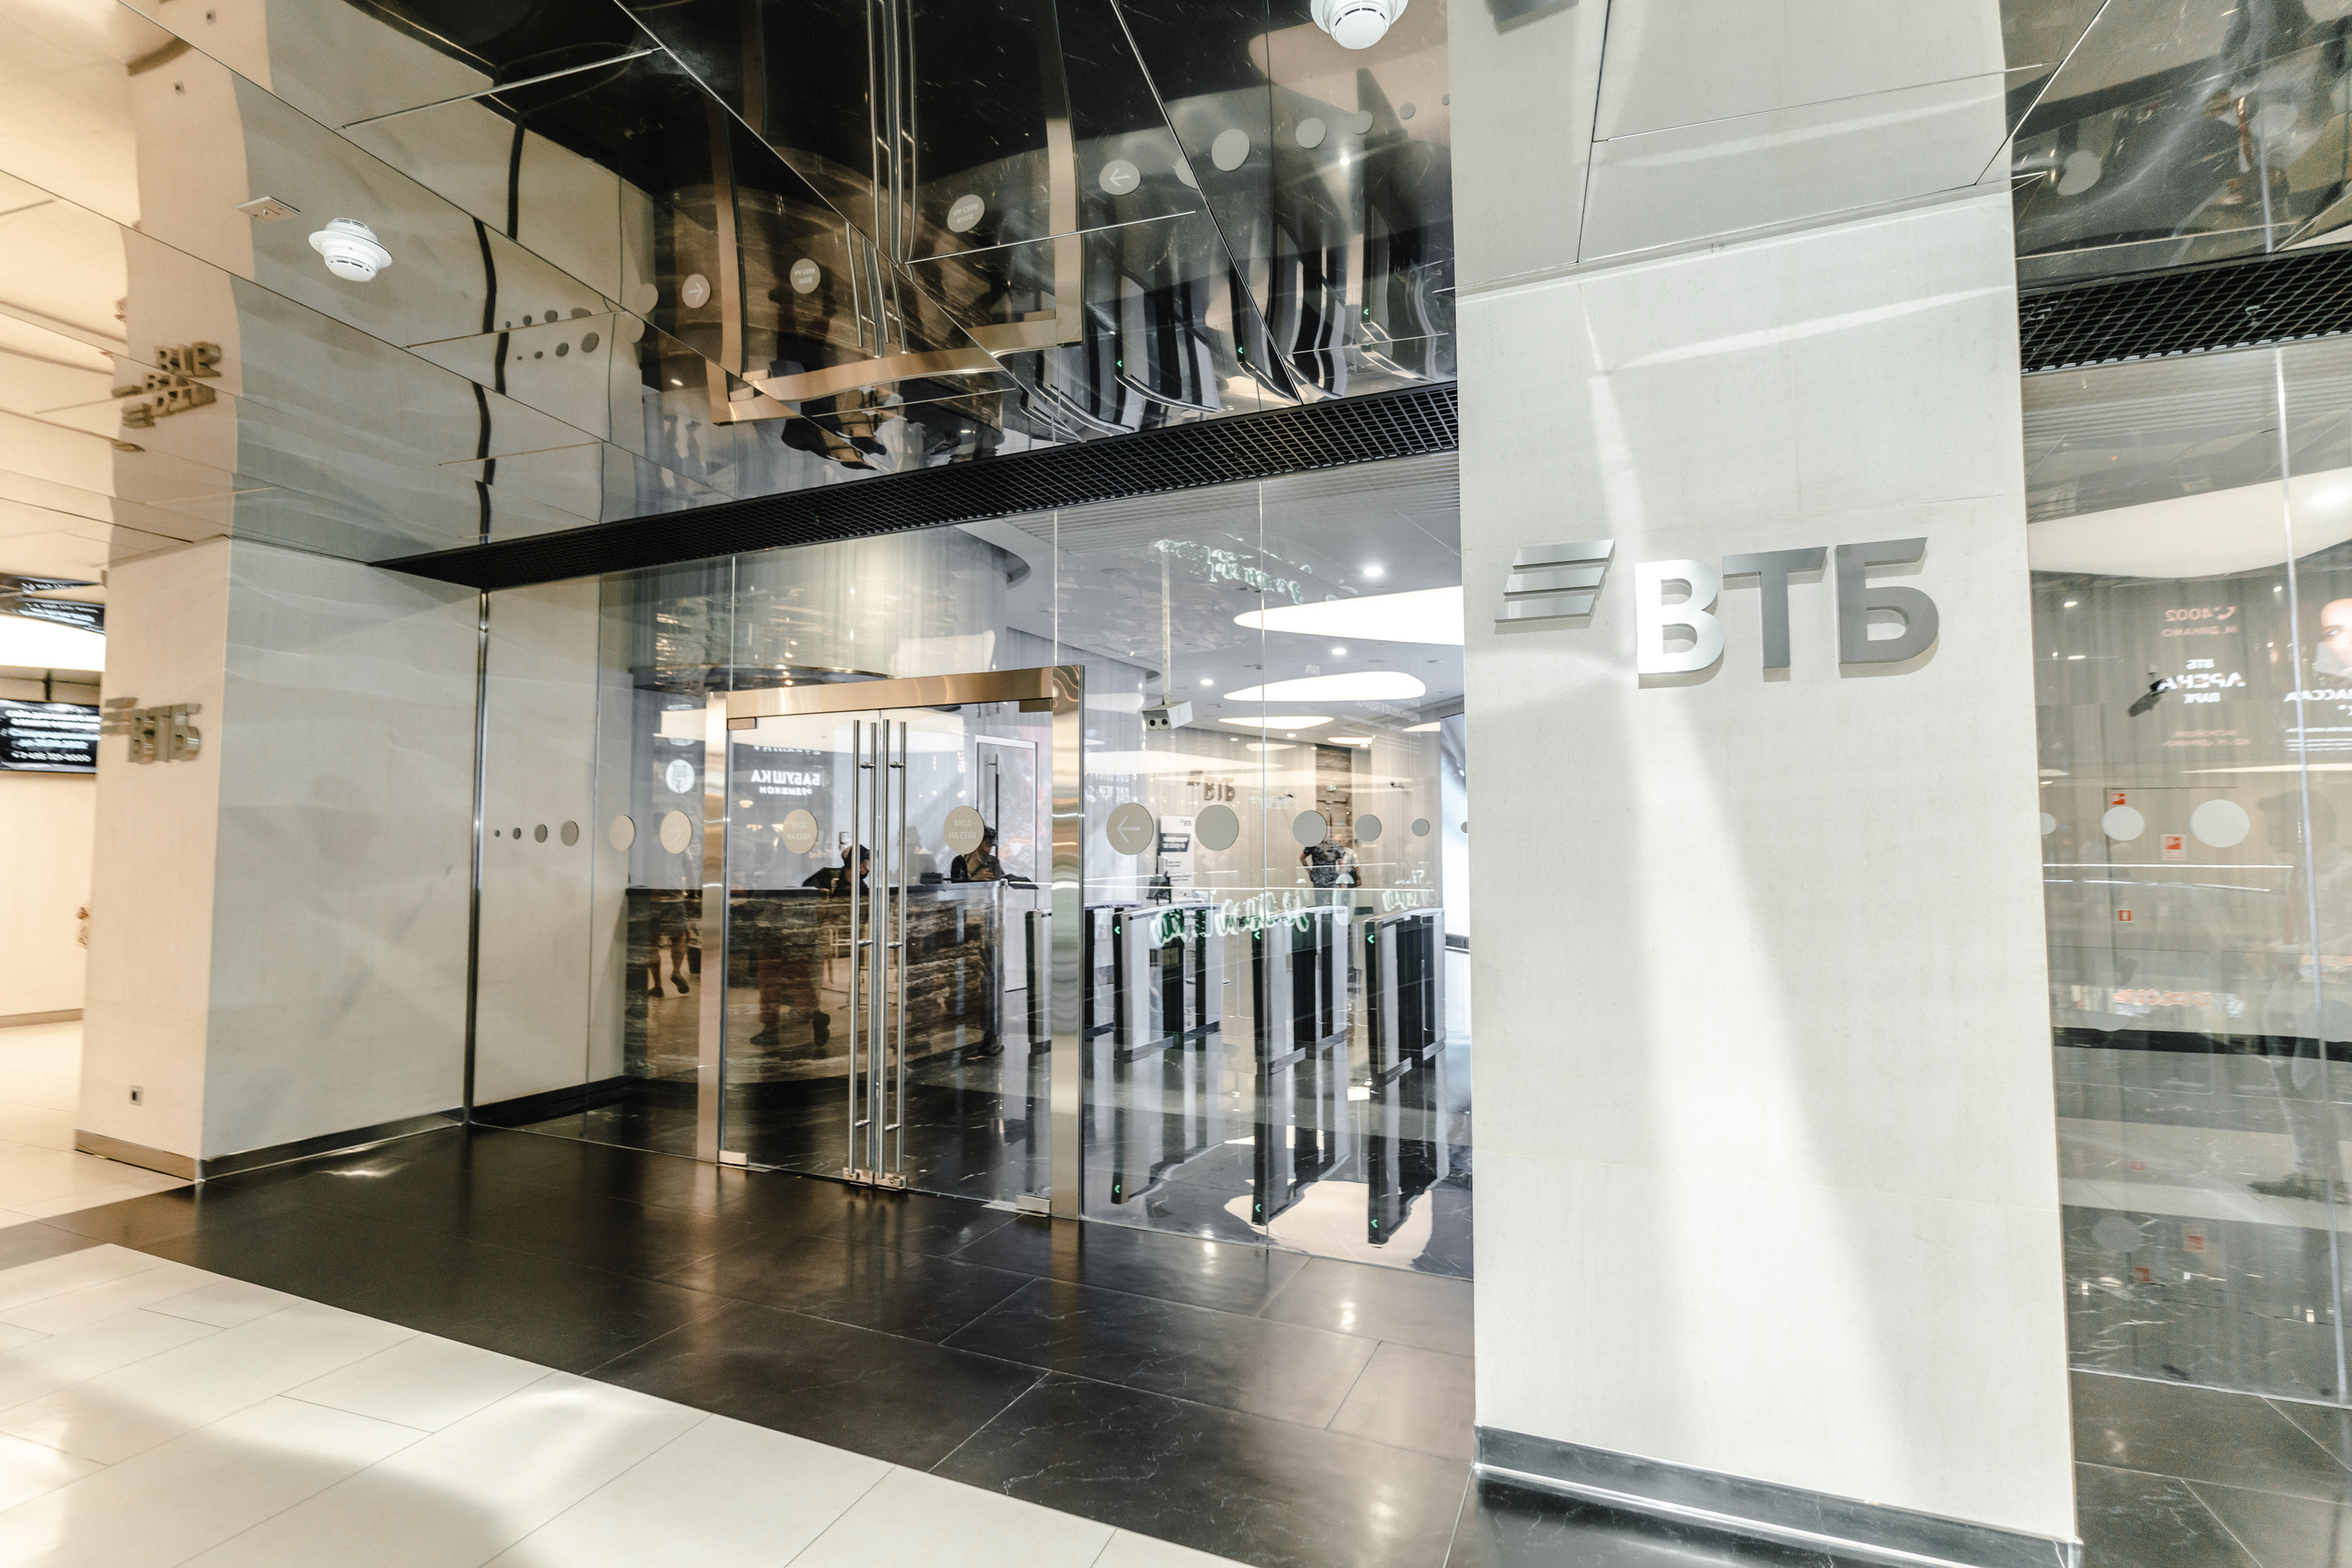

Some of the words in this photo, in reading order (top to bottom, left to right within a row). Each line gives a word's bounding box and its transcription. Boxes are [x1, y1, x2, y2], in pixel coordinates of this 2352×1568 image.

[1634, 536, 1939, 678] ВТБ
[954, 818, 972, 828] ВХОД
[949, 831, 959, 840] НА
[960, 831, 977, 840] СЕБЯ
